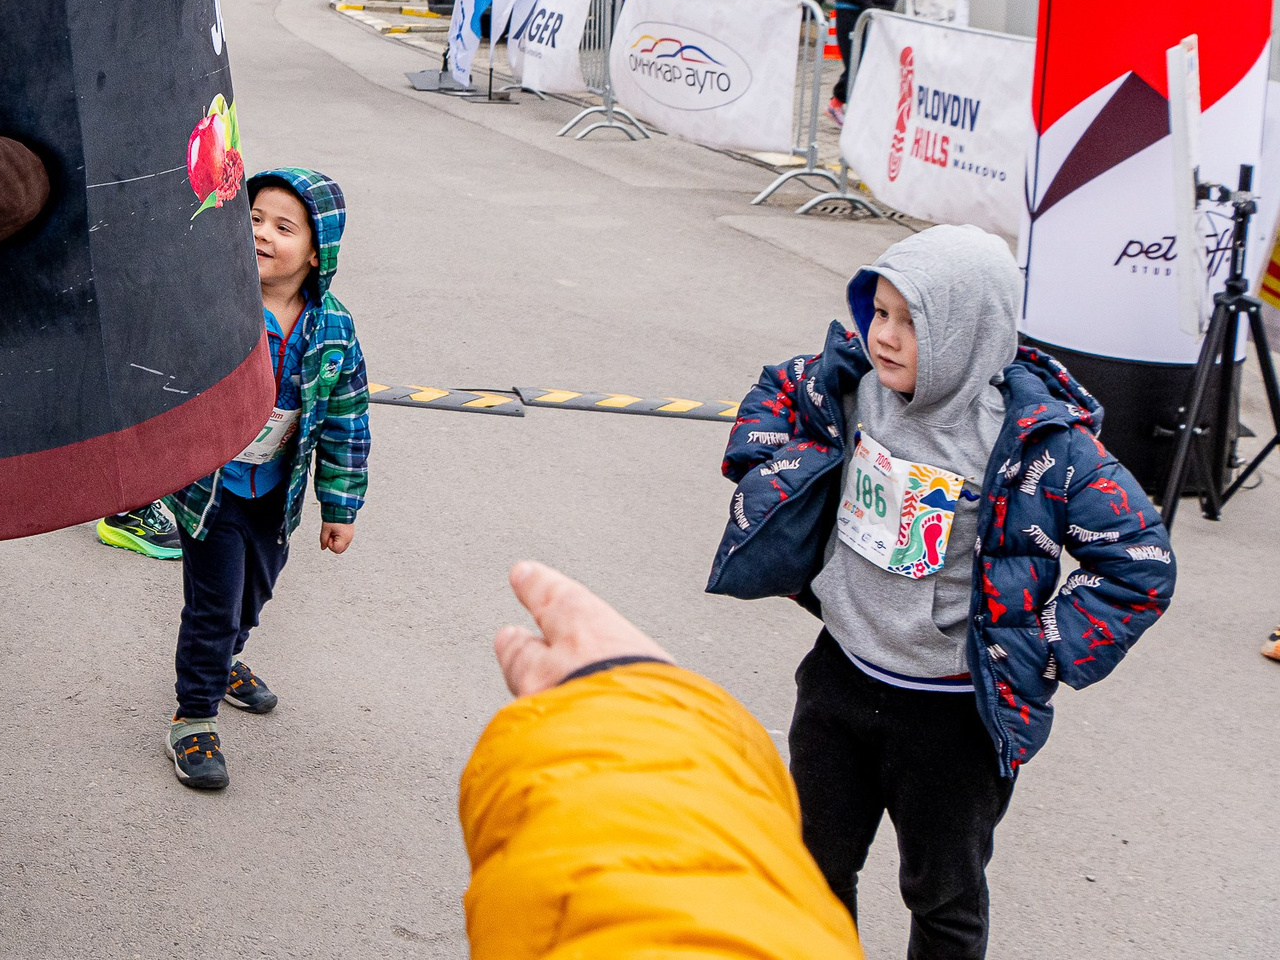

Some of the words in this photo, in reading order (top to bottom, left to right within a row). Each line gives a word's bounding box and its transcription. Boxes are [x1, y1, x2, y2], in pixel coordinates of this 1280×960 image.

[917, 85, 981, 132] PLOVDIV
[910, 127, 950, 168] HILLS
[855, 468, 887, 518] 186
